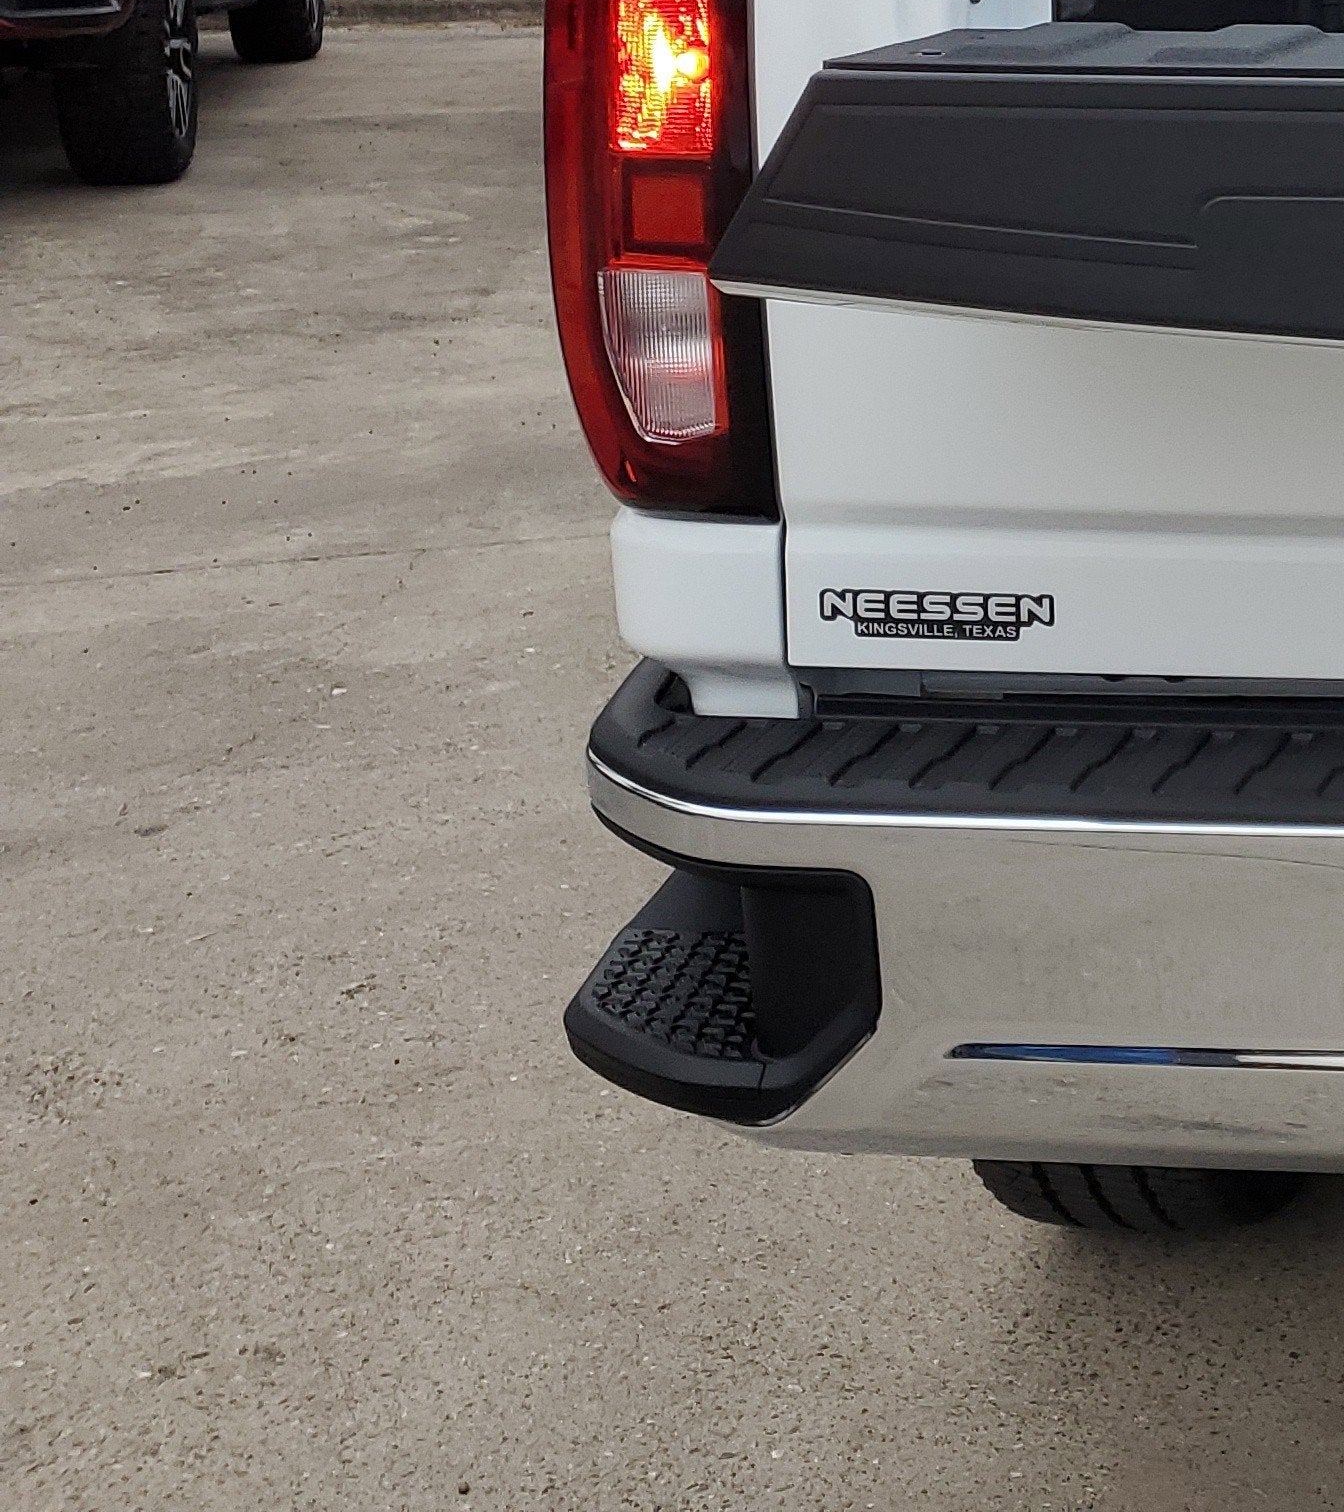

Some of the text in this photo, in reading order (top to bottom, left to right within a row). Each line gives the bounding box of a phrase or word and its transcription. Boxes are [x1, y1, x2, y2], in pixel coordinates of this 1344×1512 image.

[821, 590, 1053, 624] NEESSEN
[857, 623, 1017, 638] KINGSVILLE, TEXAS
